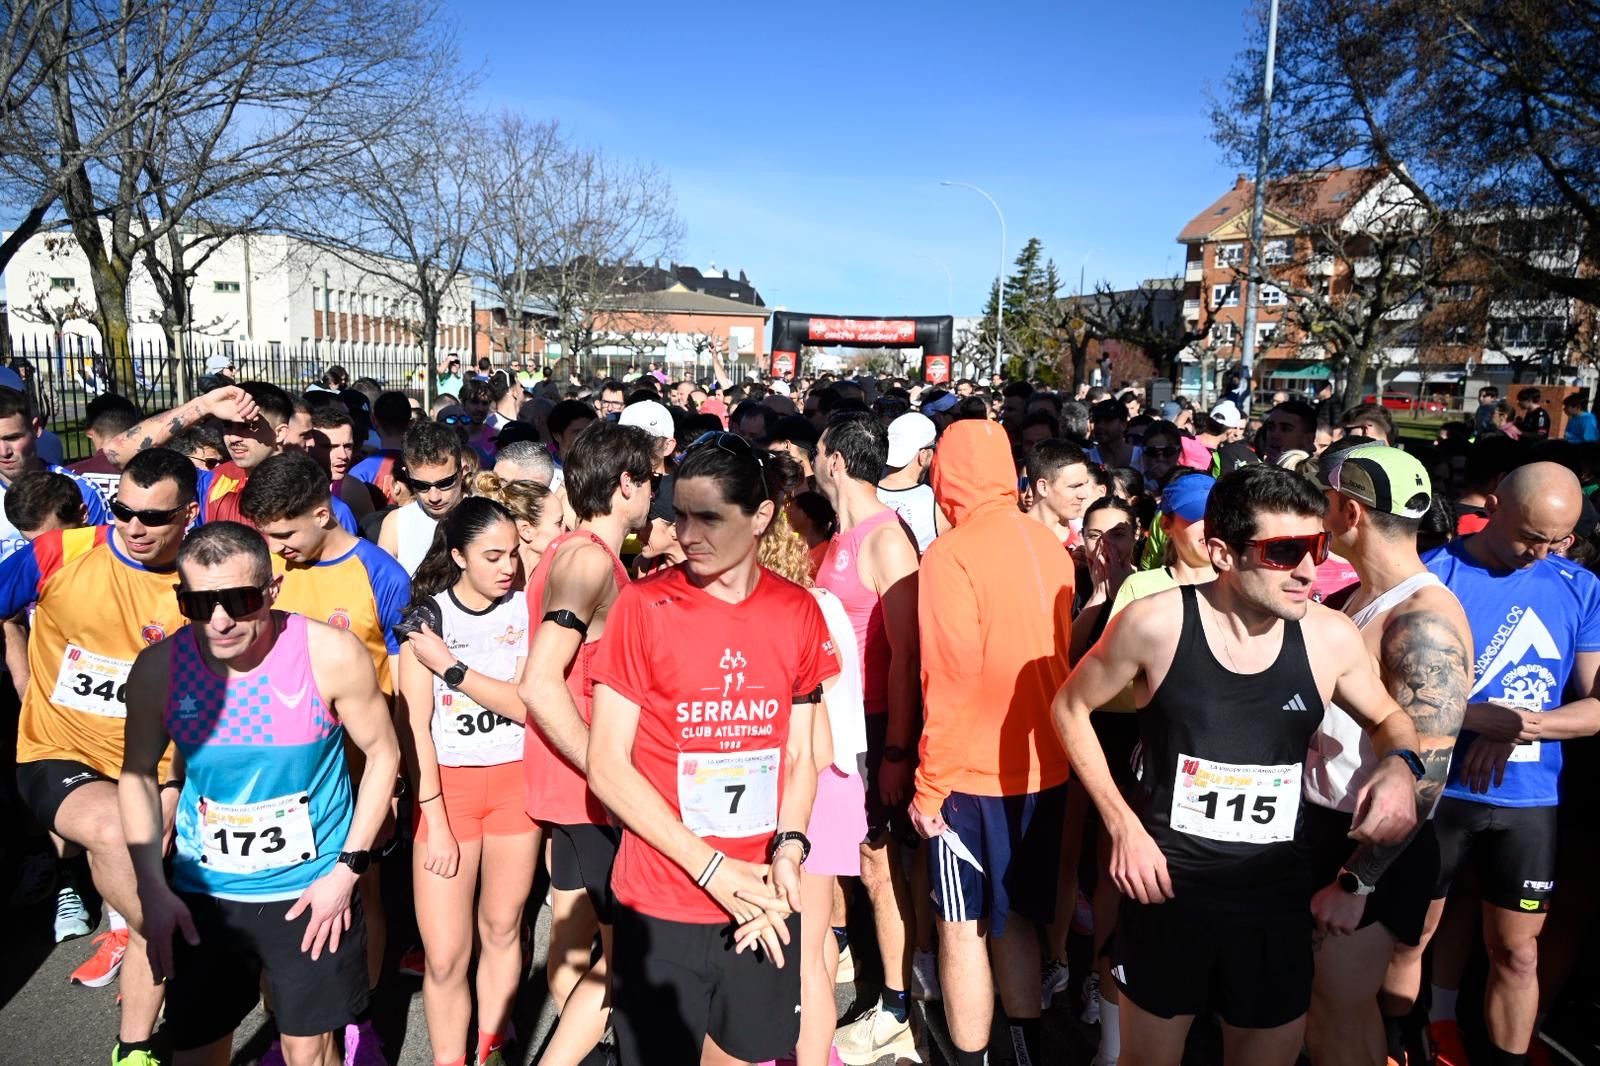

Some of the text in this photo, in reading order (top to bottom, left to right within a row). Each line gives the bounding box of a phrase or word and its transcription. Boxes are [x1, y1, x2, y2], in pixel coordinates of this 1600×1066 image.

[1474, 605, 1524, 675] SARGADELOS
[676, 698, 780, 723] SERRANO
[681, 723, 773, 739] CLUB ATLETISMO
[719, 740, 741, 750] 1988
[724, 784, 746, 814] 7
[1198, 791, 1278, 824] 115
[214, 826, 287, 857] 173
